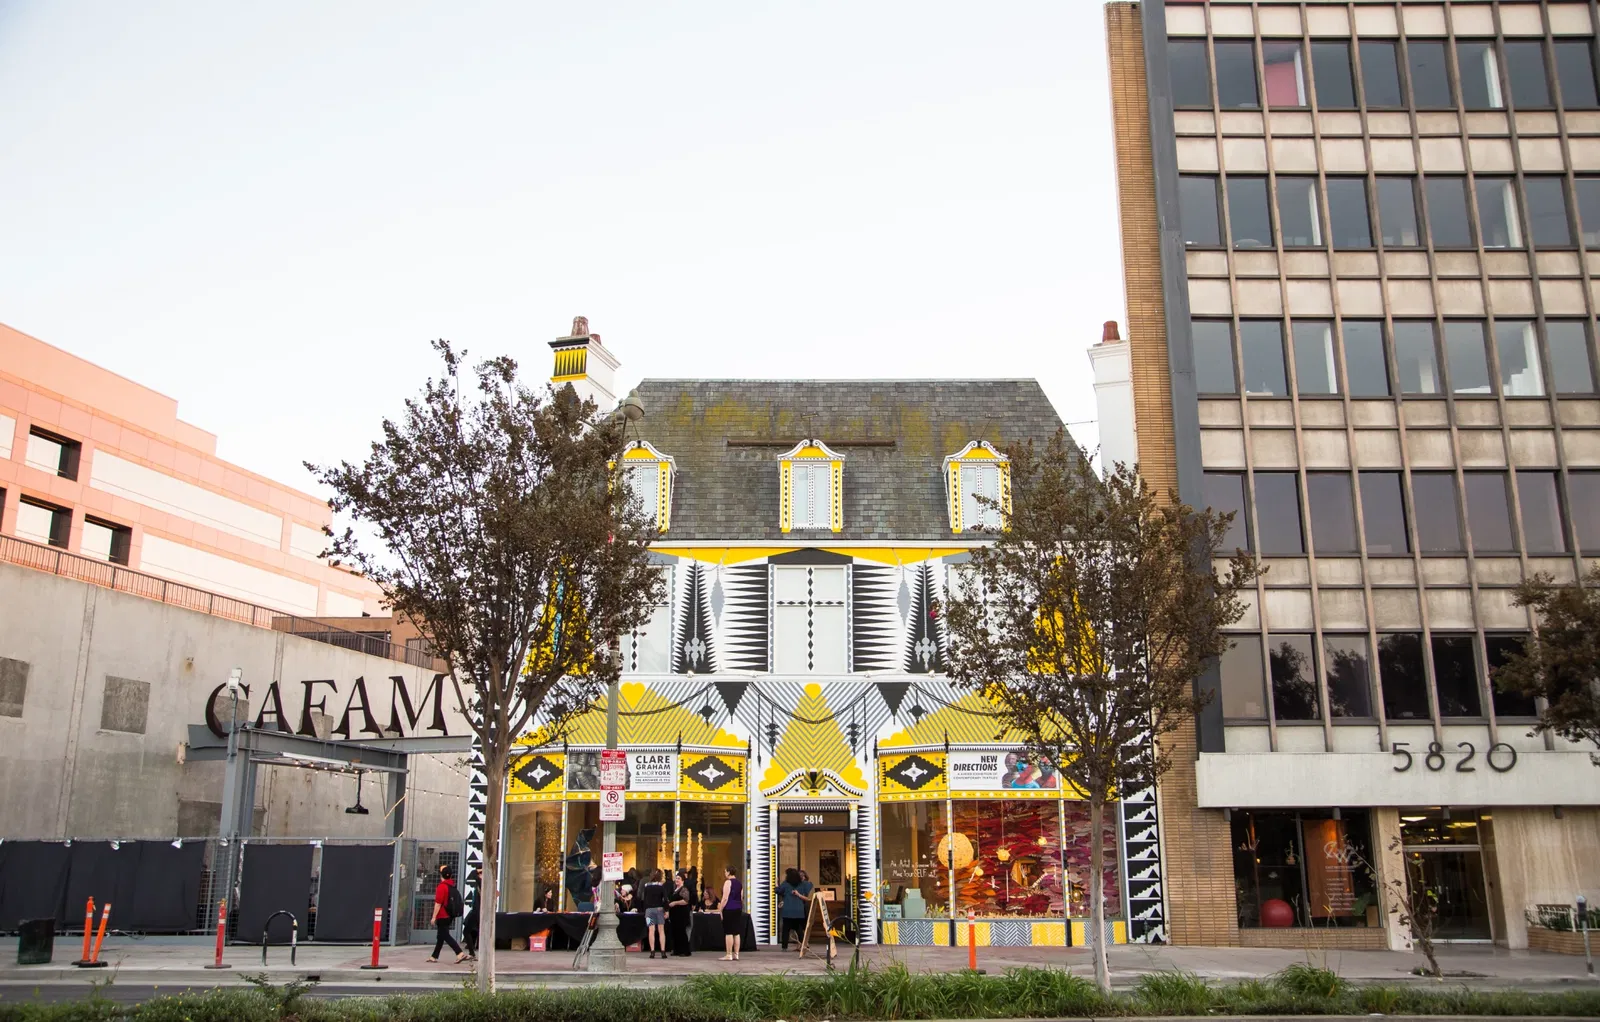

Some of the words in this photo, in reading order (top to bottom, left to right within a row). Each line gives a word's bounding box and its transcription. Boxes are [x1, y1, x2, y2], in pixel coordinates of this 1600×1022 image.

[205, 673, 450, 740] CAFAM
[635, 755, 670, 764] CLARE
[980, 755, 998, 763] NEW
[1392, 742, 1517, 773] 5820
[953, 763, 998, 771] DIRECTIONS
[803, 814, 824, 825] 5814
